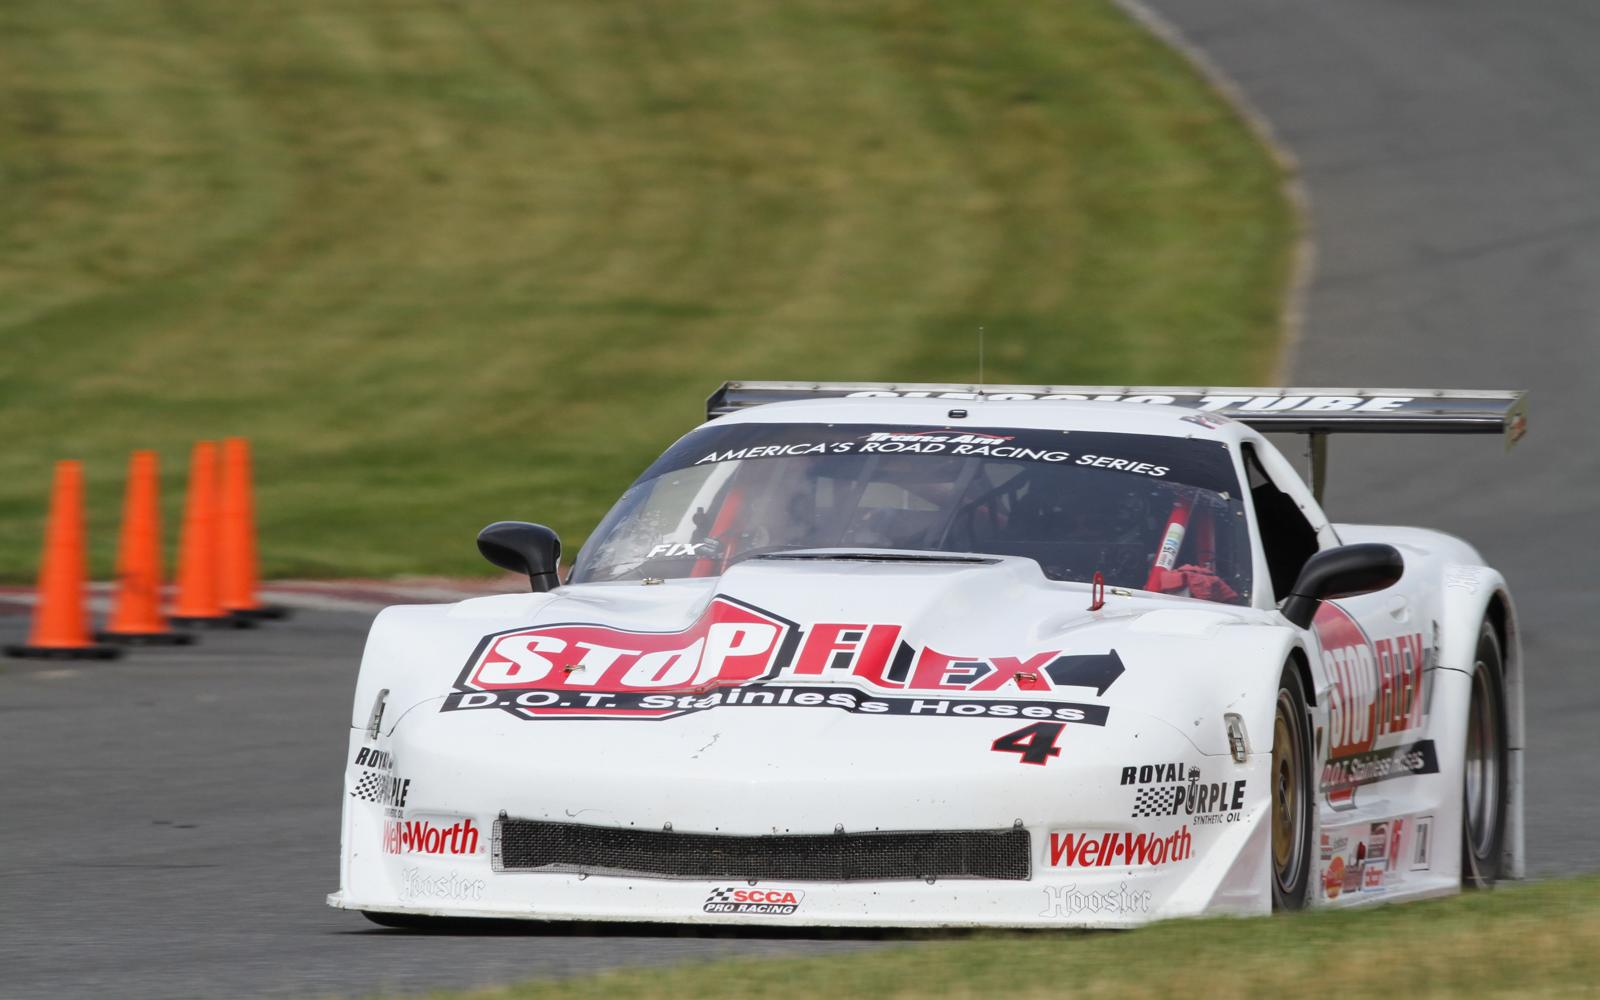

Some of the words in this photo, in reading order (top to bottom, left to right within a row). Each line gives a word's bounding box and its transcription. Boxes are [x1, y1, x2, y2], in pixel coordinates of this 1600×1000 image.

[1197, 396, 1415, 412] TUBE
[694, 442, 855, 465] AMERICA'S
[859, 442, 946, 453] ROAD
[951, 444, 1069, 462] RACING
[1075, 454, 1170, 477] SERIES
[646, 543, 705, 558] FIX
[477, 622, 777, 687] STOP
[457, 692, 617, 709] D.O.T.
[638, 688, 890, 713] Stainless
[909, 700, 1087, 721] Hoses
[1323, 643, 1376, 749] STOP
[990, 721, 1068, 767] 4
[1120, 763, 1186, 785] ROYAL
[1172, 780, 1247, 816] PURPLE
[1193, 814, 1224, 826] SYNTHETIC
[1226, 812, 1241, 823] OIL
[399, 866, 486, 901] Hoosier
[734, 890, 798, 904] SCCA
[1039, 881, 1152, 918] Hoosier
[705, 903, 735, 912] PRO
[737, 904, 795, 914] RACING
